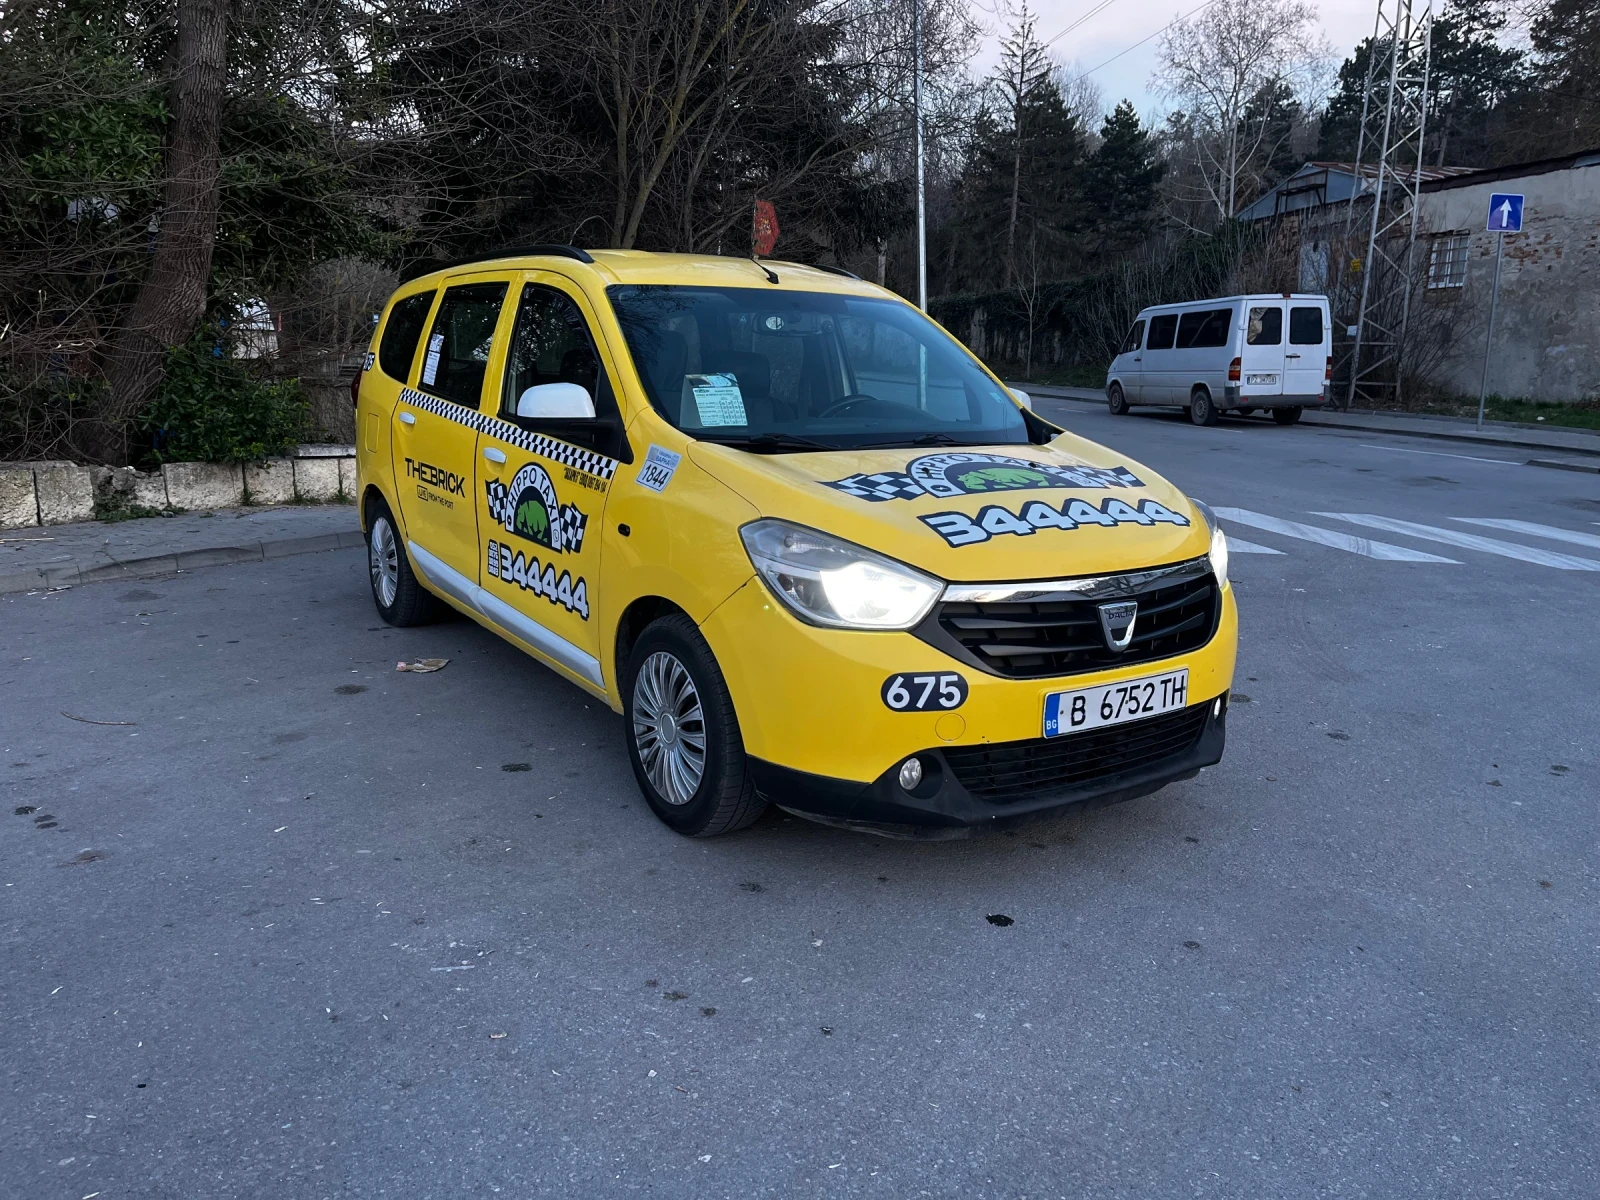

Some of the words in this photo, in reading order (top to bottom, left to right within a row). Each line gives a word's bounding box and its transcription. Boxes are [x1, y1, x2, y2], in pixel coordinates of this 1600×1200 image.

[642, 464, 670, 487] 1844
[915, 453, 973, 480] HIPPO
[509, 467, 537, 510] HIPPO
[539, 473, 559, 524] TAXI
[921, 499, 1188, 546] 344444
[500, 543, 589, 620] 344444
[1108, 611, 1135, 620] DACIA
[886, 675, 961, 709] 675
[1071, 695, 1086, 726] B
[1100, 682, 1155, 720] 6752
[1160, 675, 1184, 708] TH
[1046, 720, 1057, 730] BG
